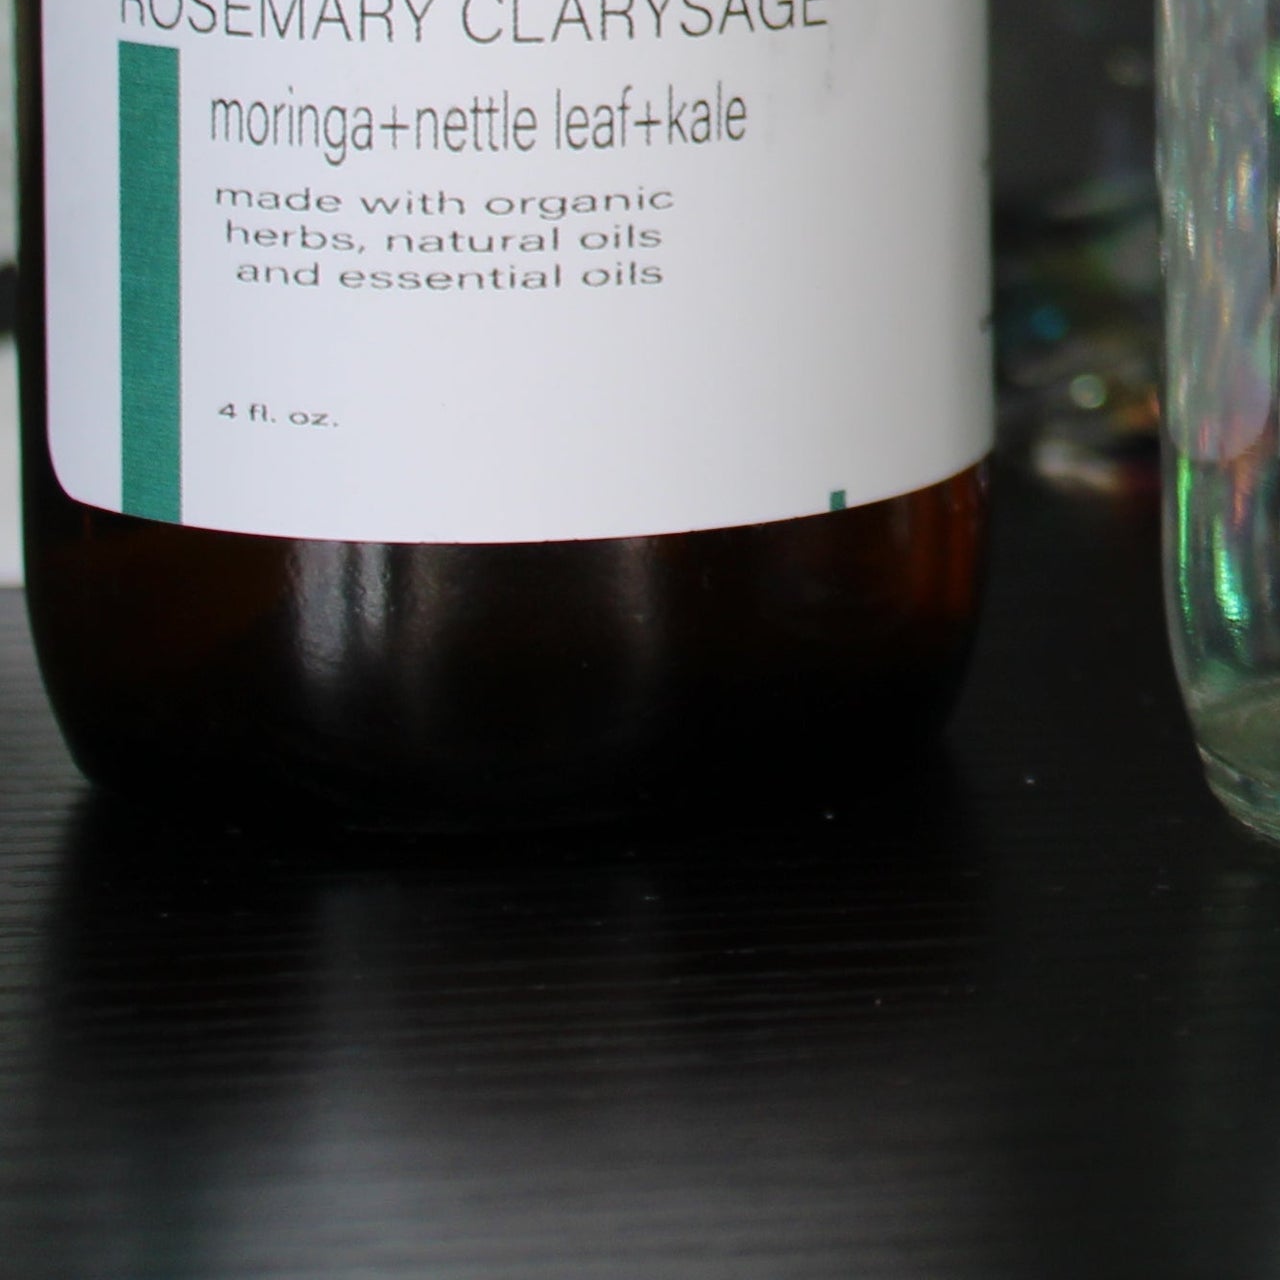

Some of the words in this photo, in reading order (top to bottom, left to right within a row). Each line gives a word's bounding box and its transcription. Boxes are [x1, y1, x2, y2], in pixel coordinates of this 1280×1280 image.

[211, 85, 538, 167] moringa+nettle
[555, 81, 747, 151] leaf+kale
[216, 187, 342, 213] made
[360, 190, 465, 215] with
[484, 186, 673, 221] organic
[226, 219, 365, 254] herbs,
[387, 226, 559, 253] natural
[579, 224, 662, 250] oils
[236, 262, 319, 286] and
[339, 264, 561, 290] essential
[581, 261, 663, 287] oils
[218, 403, 237, 419] 4
[249, 403, 275, 423] fl.
[289, 412, 338, 427] oz.
